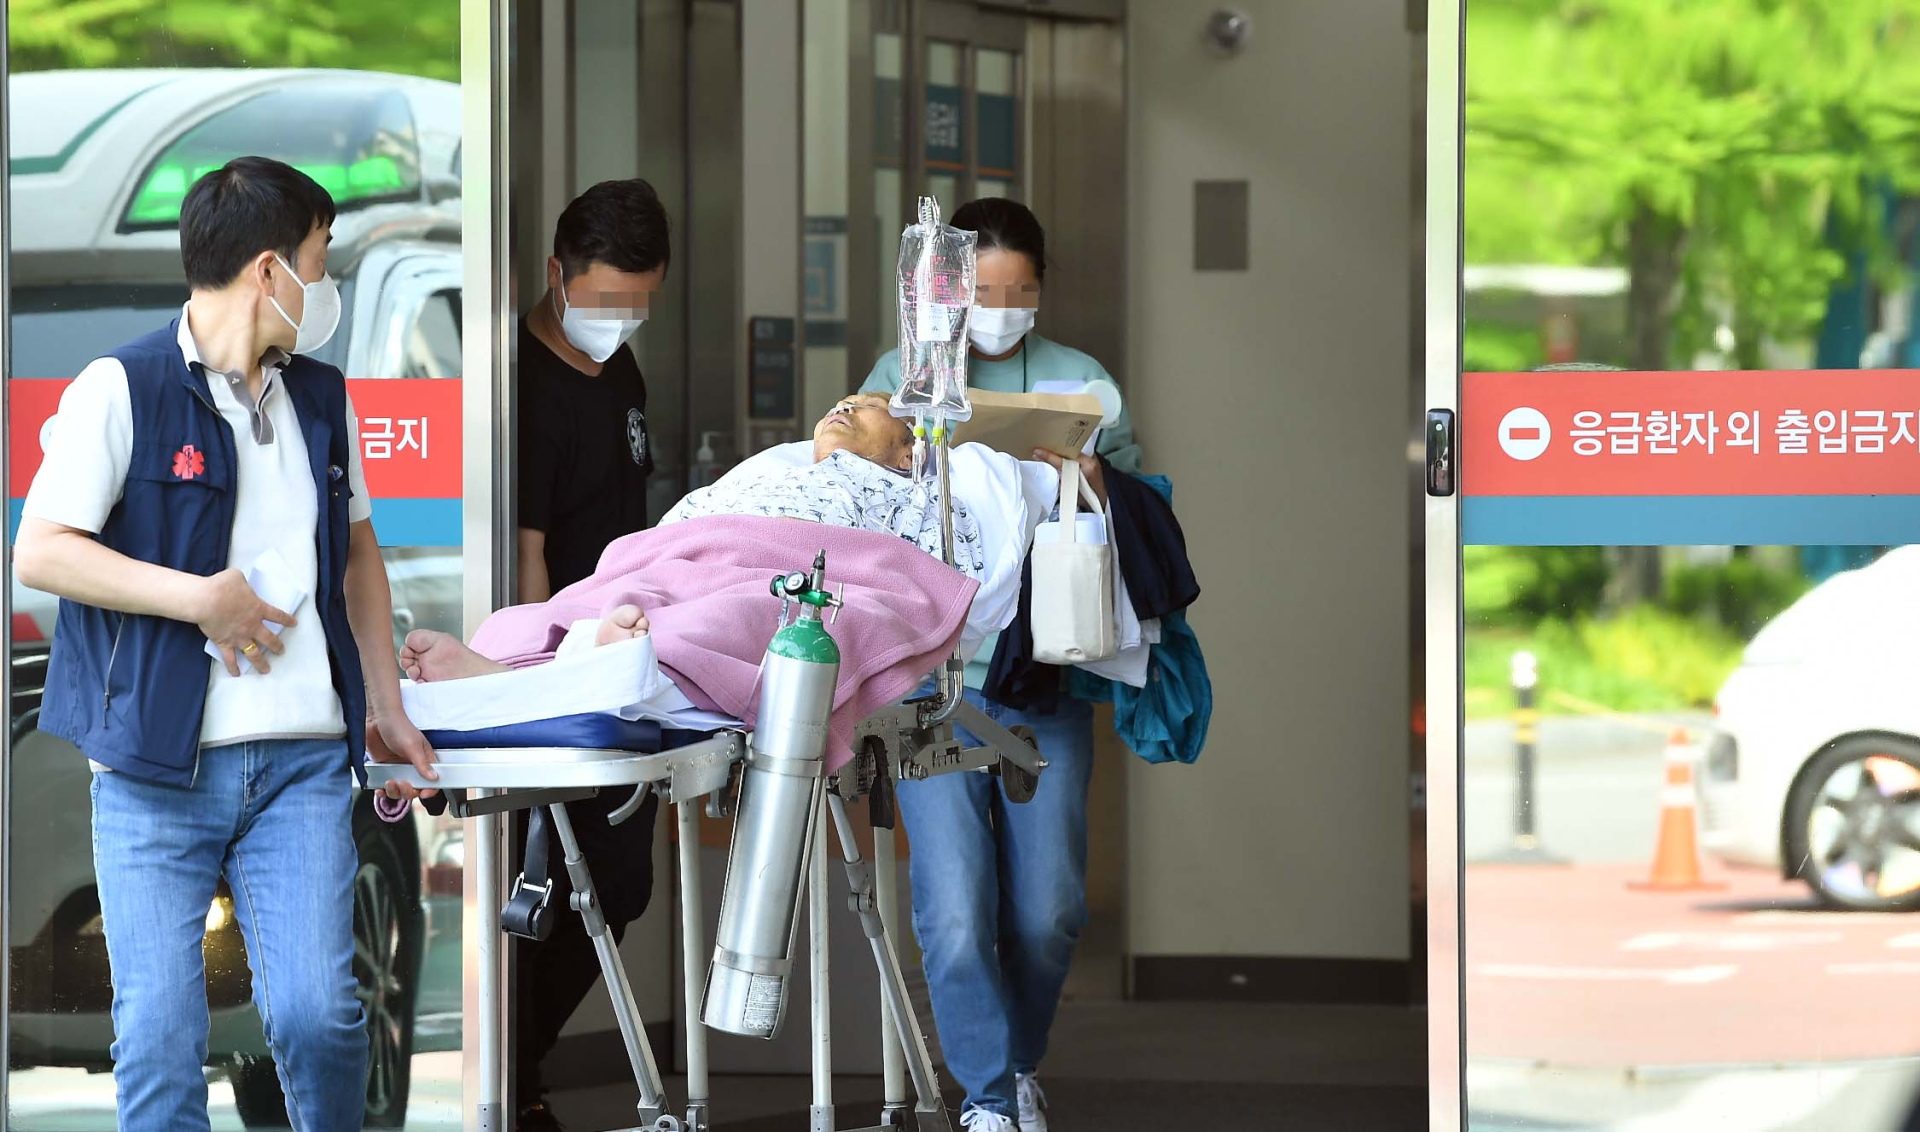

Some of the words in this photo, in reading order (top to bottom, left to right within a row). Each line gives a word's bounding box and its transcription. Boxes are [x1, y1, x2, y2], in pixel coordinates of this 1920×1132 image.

[355, 416, 428, 459] 금지
[1569, 410, 1719, 455] 응급환자
[1725, 410, 1760, 454] 외
